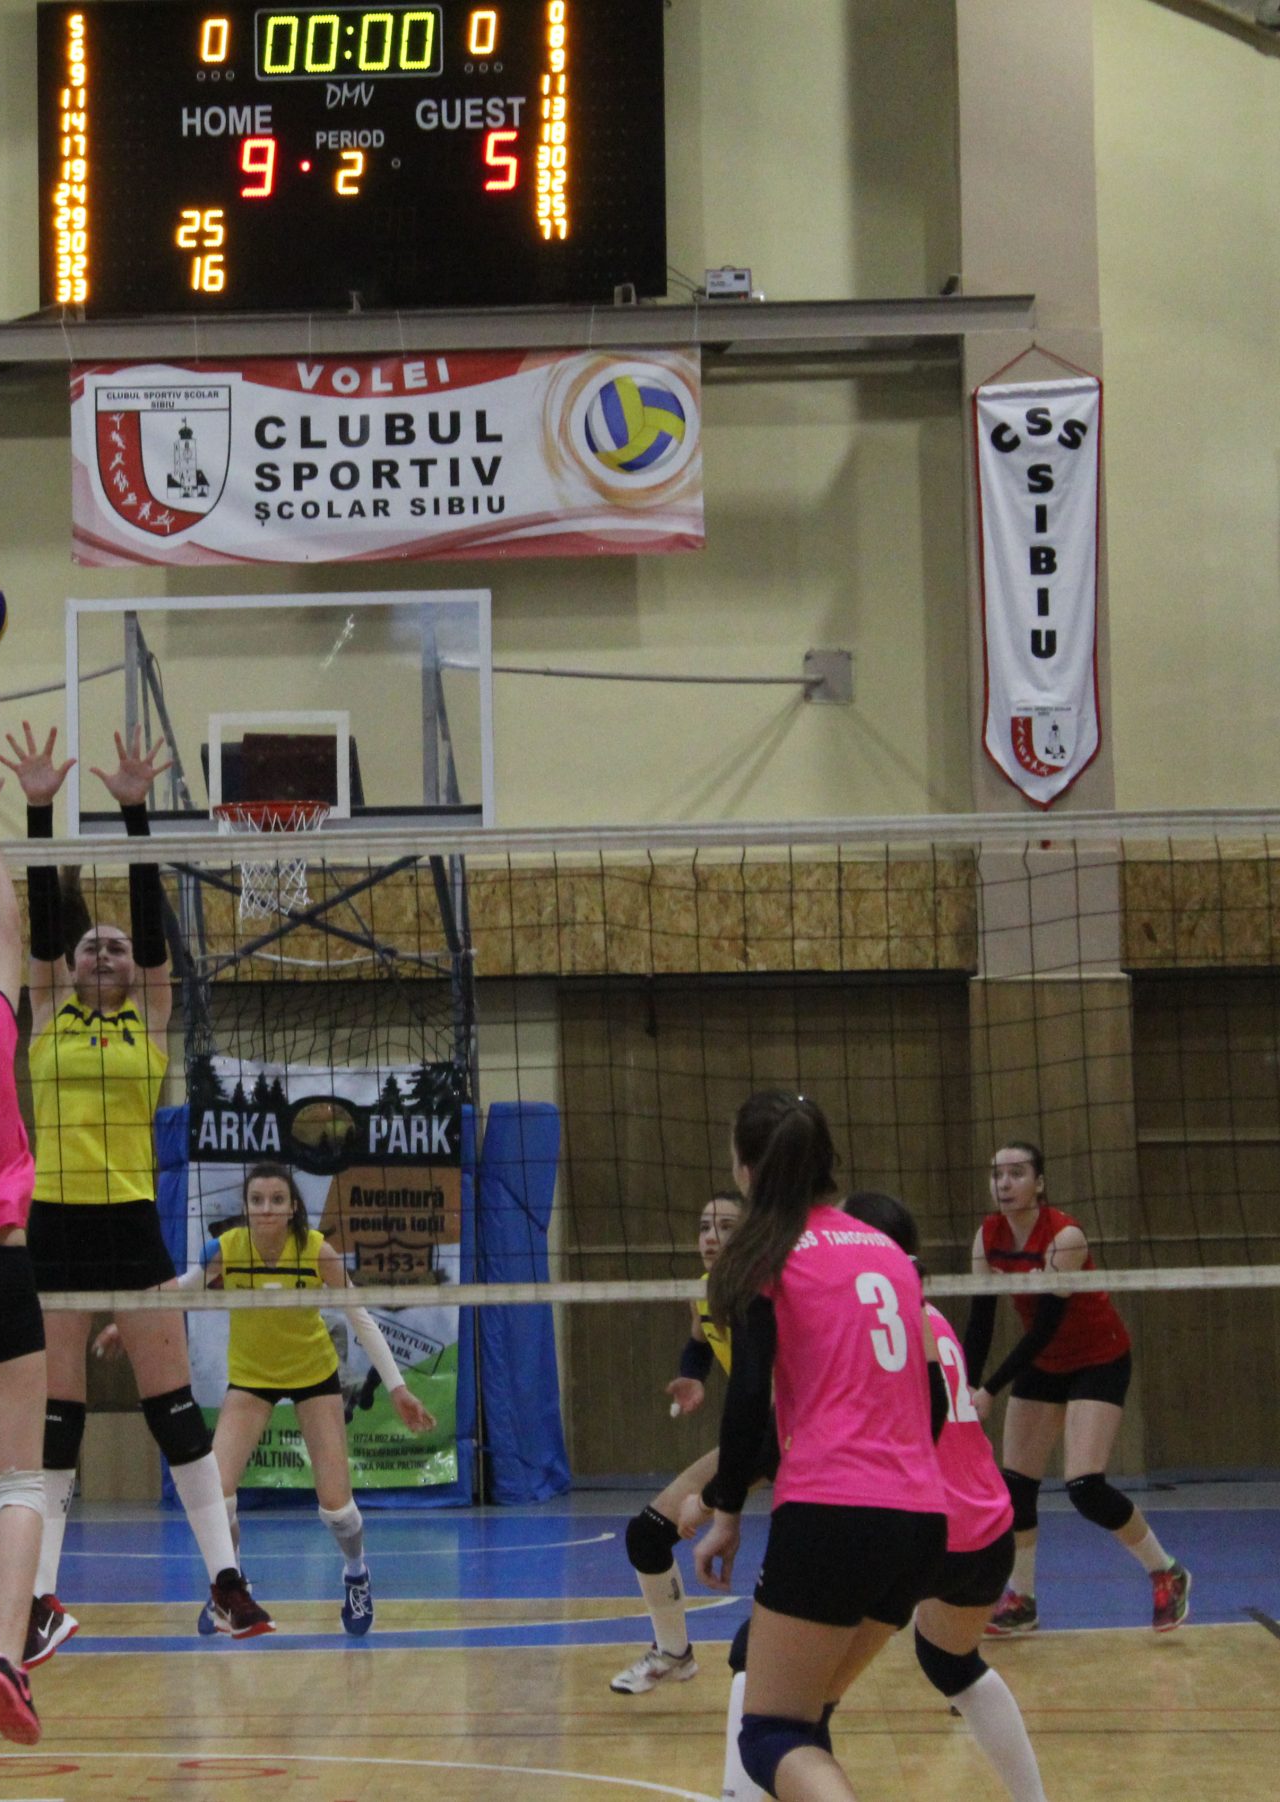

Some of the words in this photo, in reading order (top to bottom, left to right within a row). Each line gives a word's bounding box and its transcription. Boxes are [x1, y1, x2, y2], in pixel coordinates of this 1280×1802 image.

[69, 14, 84, 39] 5
[470, 10, 497, 55] 0
[548, 24, 565, 48] 8
[69, 39, 84, 62] 6
[201, 18, 229, 63] 0
[264, 11, 435, 74] 00:00
[550, 48, 566, 73] 9
[69, 62, 85, 87] 9
[542, 74, 566, 95] 11
[62, 87, 86, 109] 11
[325, 81, 374, 109] DMV
[181, 104, 273, 137] HOME
[415, 96, 526, 131] GUEST
[542, 97, 566, 121] 13
[62, 112, 86, 133] 14
[543, 121, 566, 144] 18
[62, 134, 86, 157] 17
[315, 129, 384, 150] PERIOD
[241, 138, 276, 197] 9
[485, 131, 518, 191] 5
[537, 145, 567, 169] 30
[63, 158, 87, 182] 19
[336, 151, 364, 195] 2
[537, 169, 567, 193] 32
[55, 183, 86, 206] 24
[537, 193, 567, 217] 35
[55, 206, 87, 230] 29
[177, 209, 224, 248] 25
[539, 217, 567, 240] 77
[57, 230, 87, 254] 30
[57, 254, 87, 278] 32
[192, 254, 224, 292] 16
[57, 278, 87, 303] 33
[296, 357, 451, 394] VOLEI
[254, 409, 504, 450] CLUBUL
[991, 406, 1088, 454] CSS
[254, 456, 504, 493] SPORTIV
[410, 495, 506, 518] SIBIU
[1026, 463, 1058, 660] SIBIU
[198, 1110, 281, 1152] ARKA
[369, 1114, 452, 1154] PARK
[855, 1272, 908, 1374] 3
